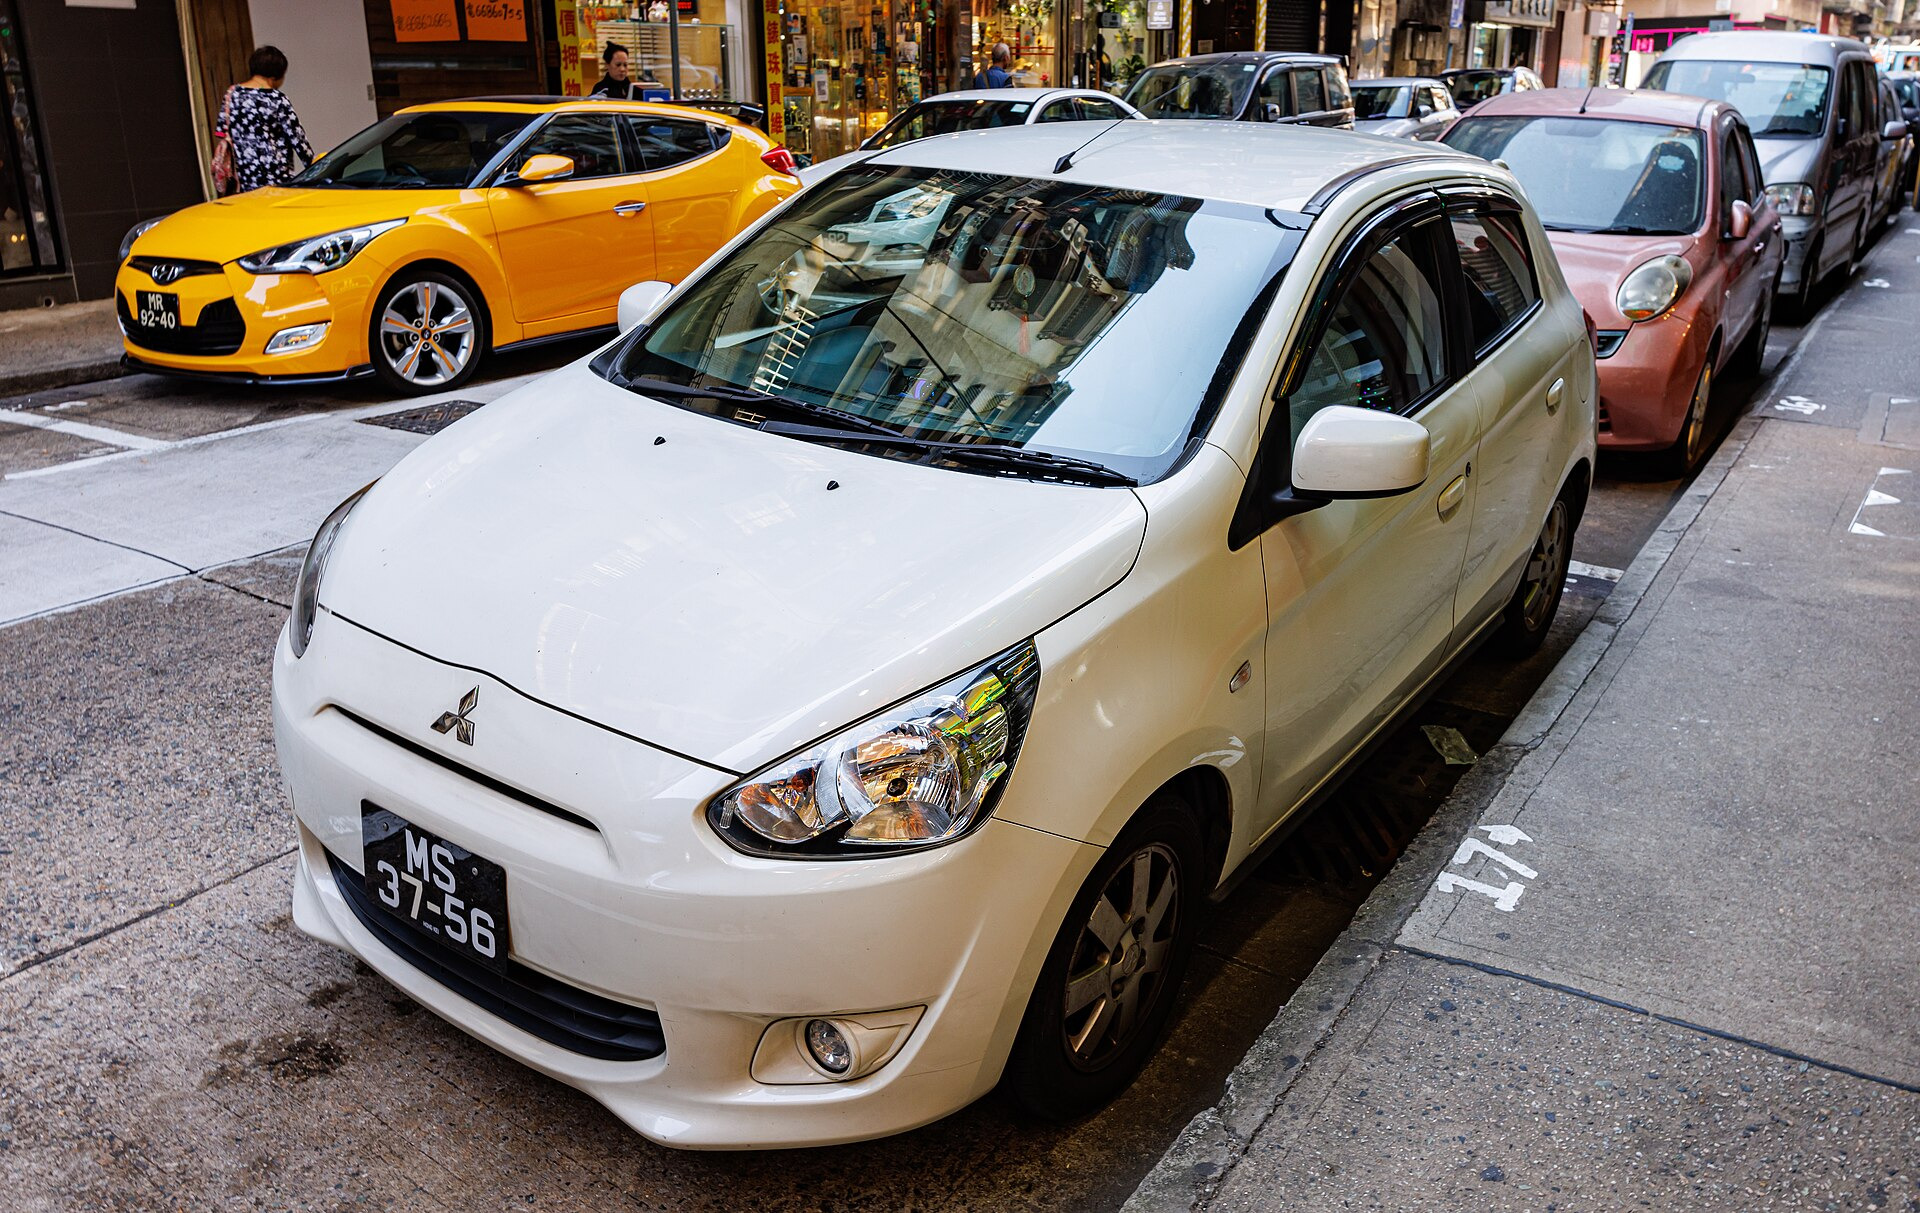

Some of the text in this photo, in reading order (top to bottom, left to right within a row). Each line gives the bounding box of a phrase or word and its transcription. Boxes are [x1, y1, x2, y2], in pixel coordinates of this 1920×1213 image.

[559, 0, 581, 96] 價押物
[140, 309, 176, 329] 92-40
[148, 293, 163, 311] MR
[405, 828, 456, 894] MS
[377, 859, 496, 959] 37-56
